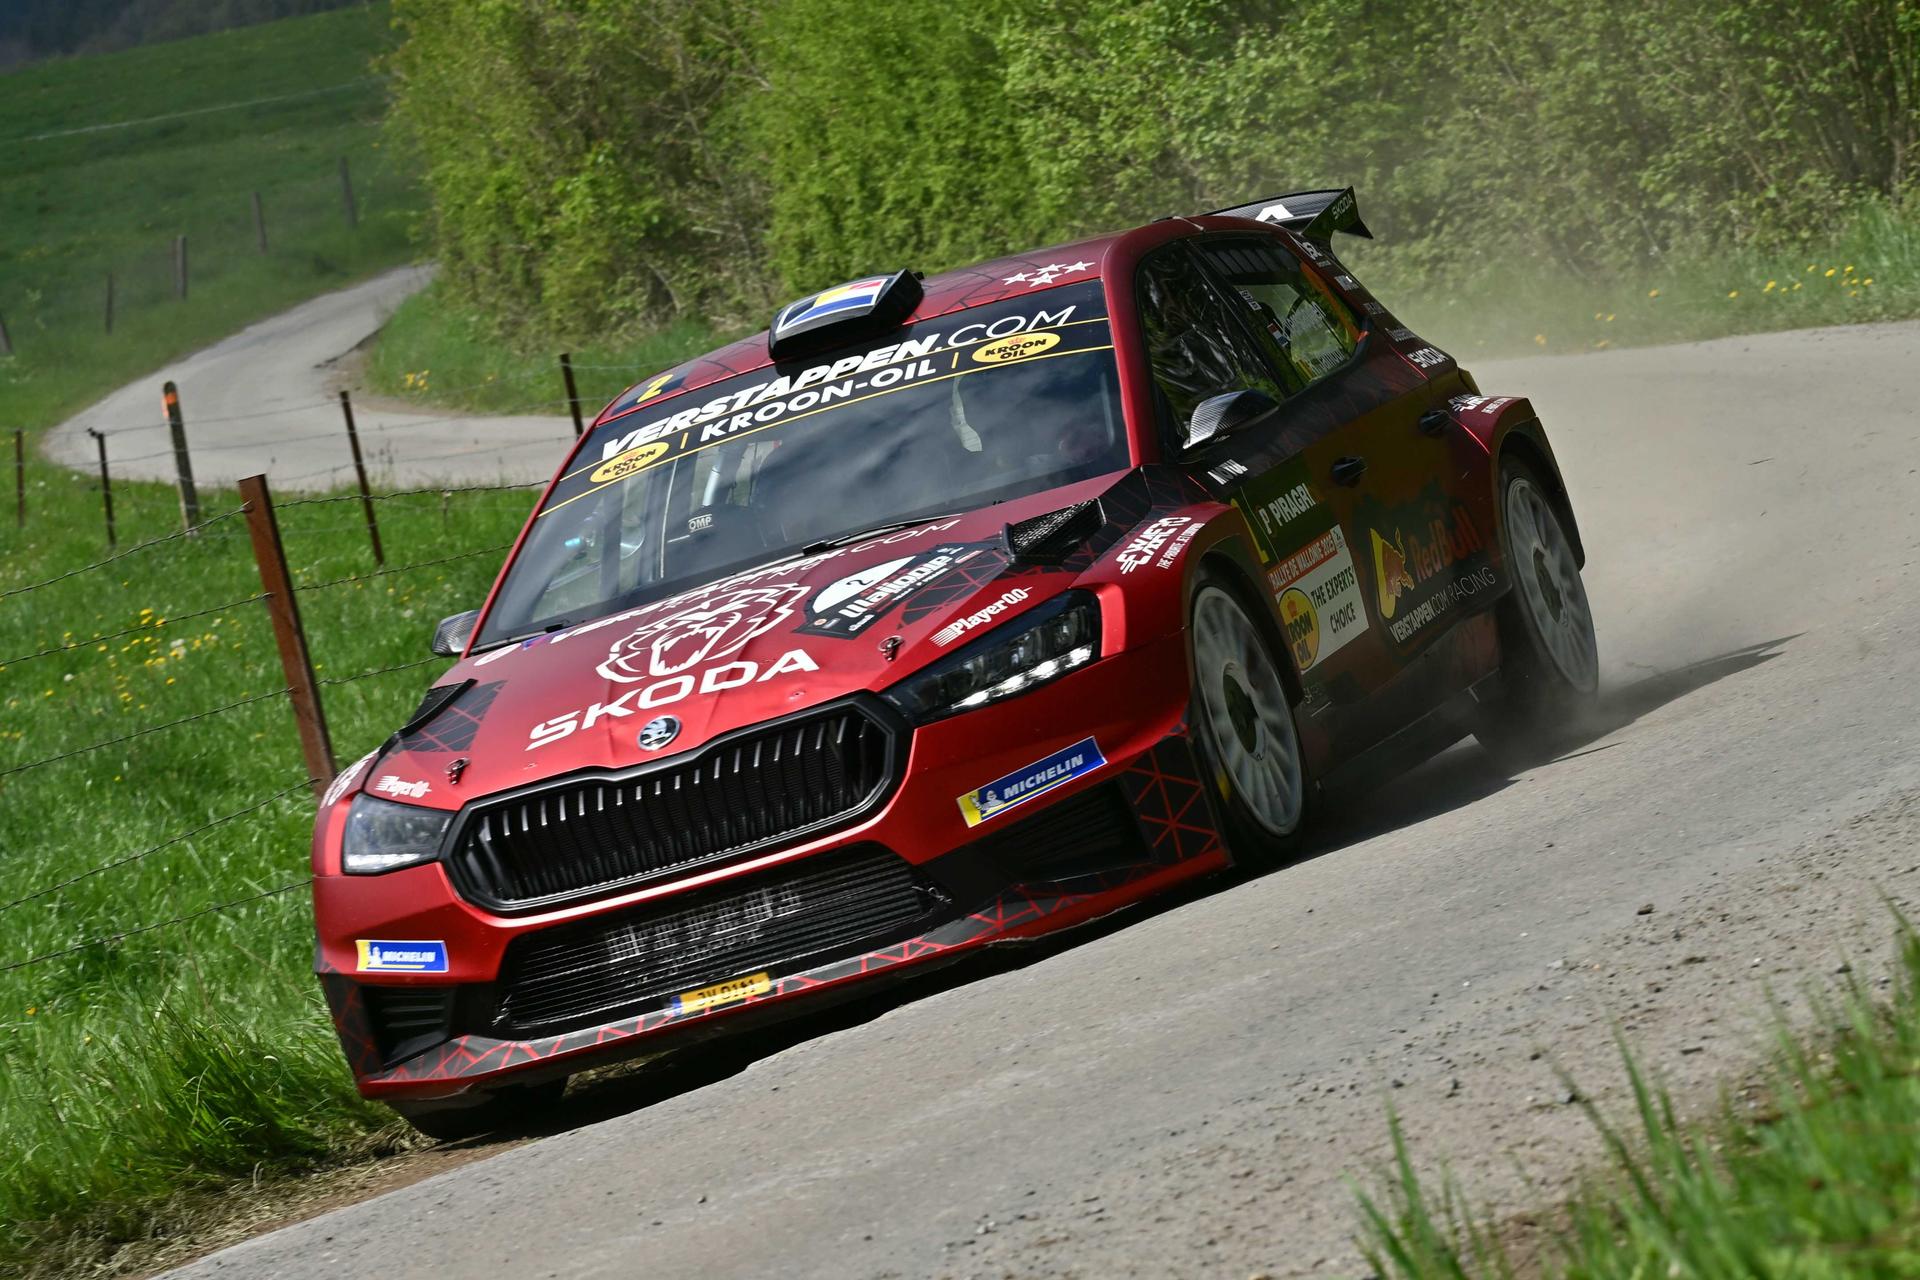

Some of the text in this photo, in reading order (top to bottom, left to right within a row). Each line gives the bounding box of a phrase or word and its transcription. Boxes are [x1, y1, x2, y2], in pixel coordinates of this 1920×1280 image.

[984, 338, 1047, 357] KROON
[1000, 350, 1027, 359] OIL
[601, 305, 1077, 461] VERSTAPPEN.COM
[636, 374, 674, 404] 2
[700, 359, 937, 442] KROON-OIL
[602, 449, 657, 475] KROON
[614, 463, 638, 476] OIL
[1207, 459, 1248, 485] MOTUL
[689, 517, 712, 530] OMP
[1449, 567, 1496, 602] RACING
[1310, 587, 1327, 609] THE
[1329, 601, 1357, 633] CHOICE
[524, 649, 820, 751] SKODA
[1003, 754, 1084, 800] MICHELIN
[382, 951, 437, 963] MICHELIN
